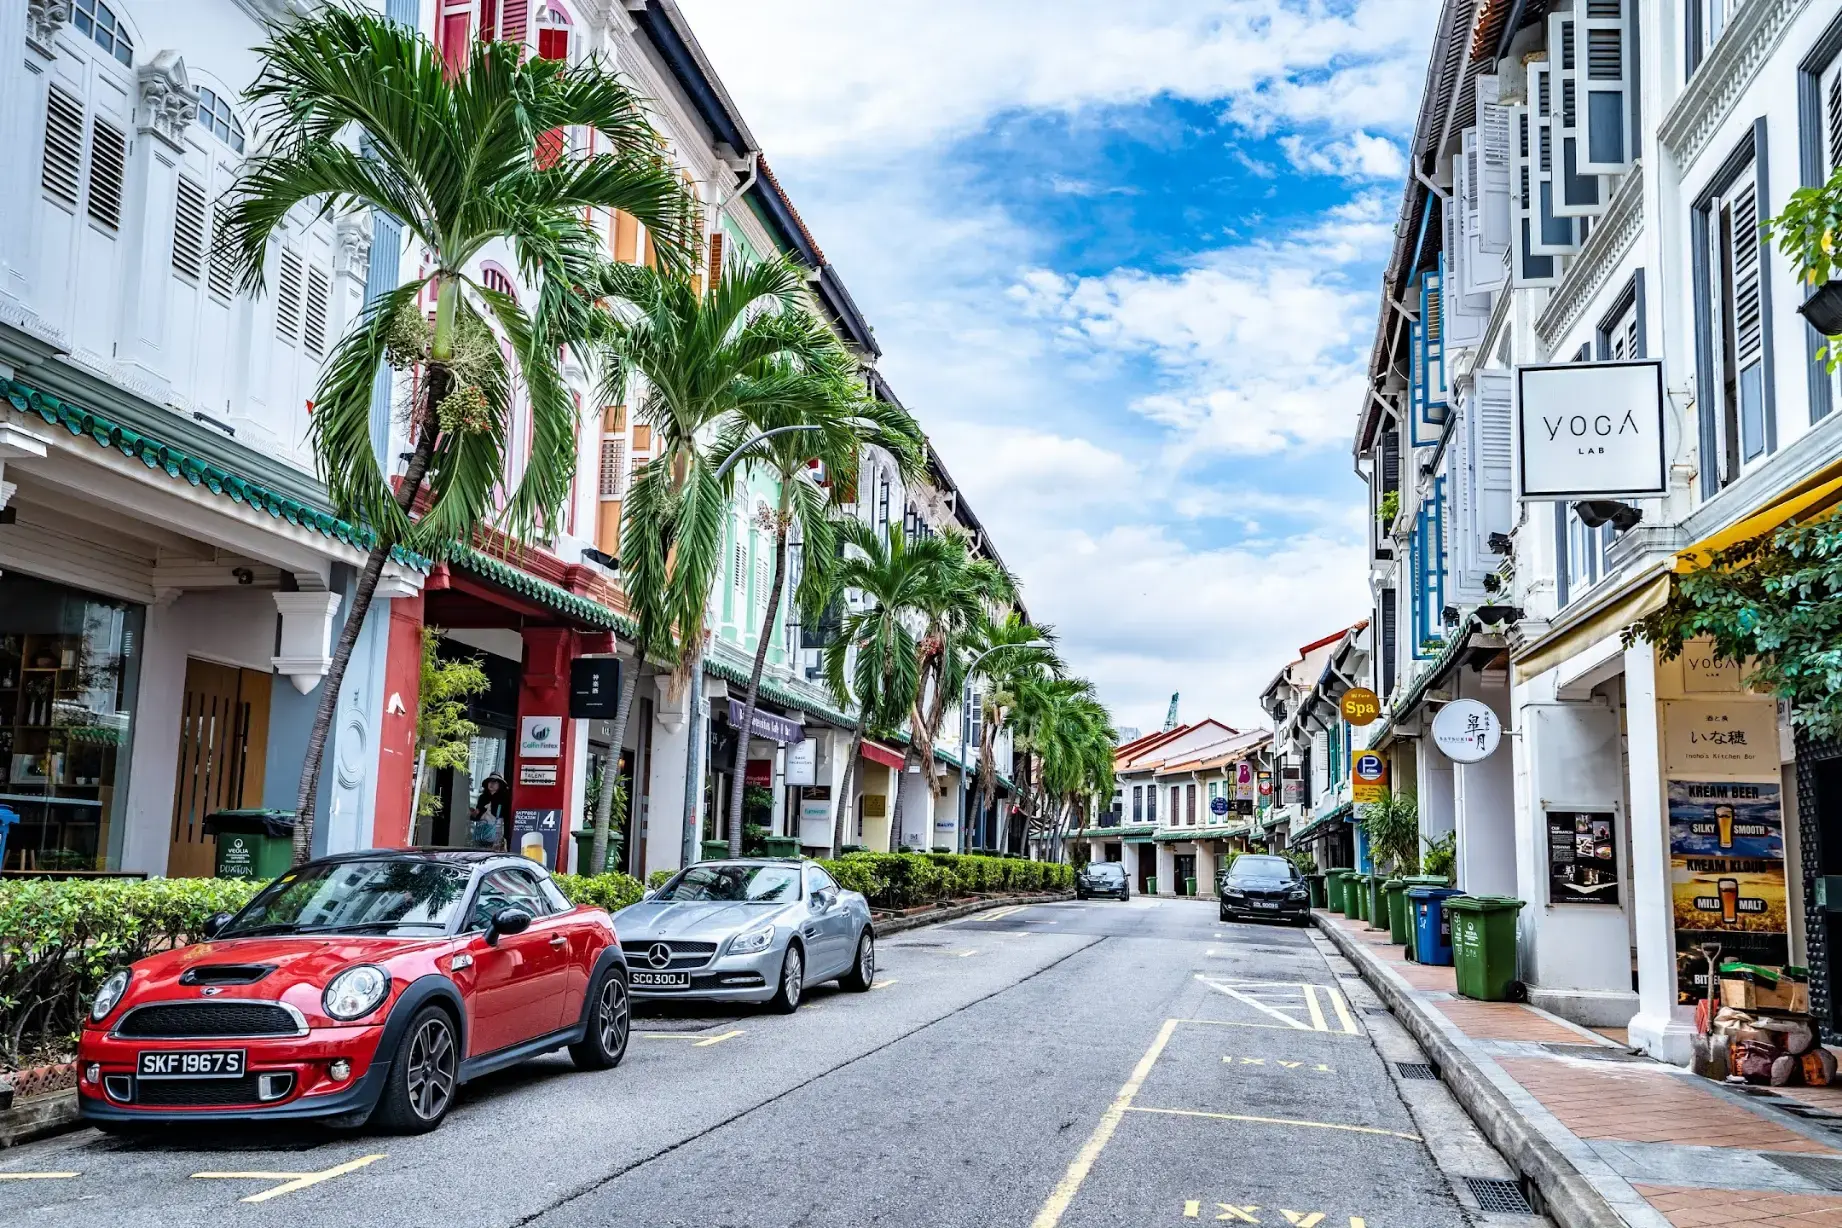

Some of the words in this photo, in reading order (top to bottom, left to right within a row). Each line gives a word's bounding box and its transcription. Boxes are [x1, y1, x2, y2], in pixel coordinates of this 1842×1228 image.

[1543, 410, 1639, 441] YOGA
[1578, 447, 1605, 455] LAB
[1689, 658, 1735, 670] YOGA
[1346, 701, 1375, 717] Spa
[1362, 756, 1379, 773] P
[1688, 785, 1728, 798] KREAM
[1731, 786, 1759, 799] BEER
[542, 810, 556, 828] 4
[1692, 824, 1715, 833] SILKY
[1733, 825, 1765, 835] SMOOTH
[1686, 859, 1726, 872] KREAM
[1697, 898, 1720, 909] MILD
[1739, 900, 1762, 911] MALT
[1694, 974, 1720, 985] BITE
